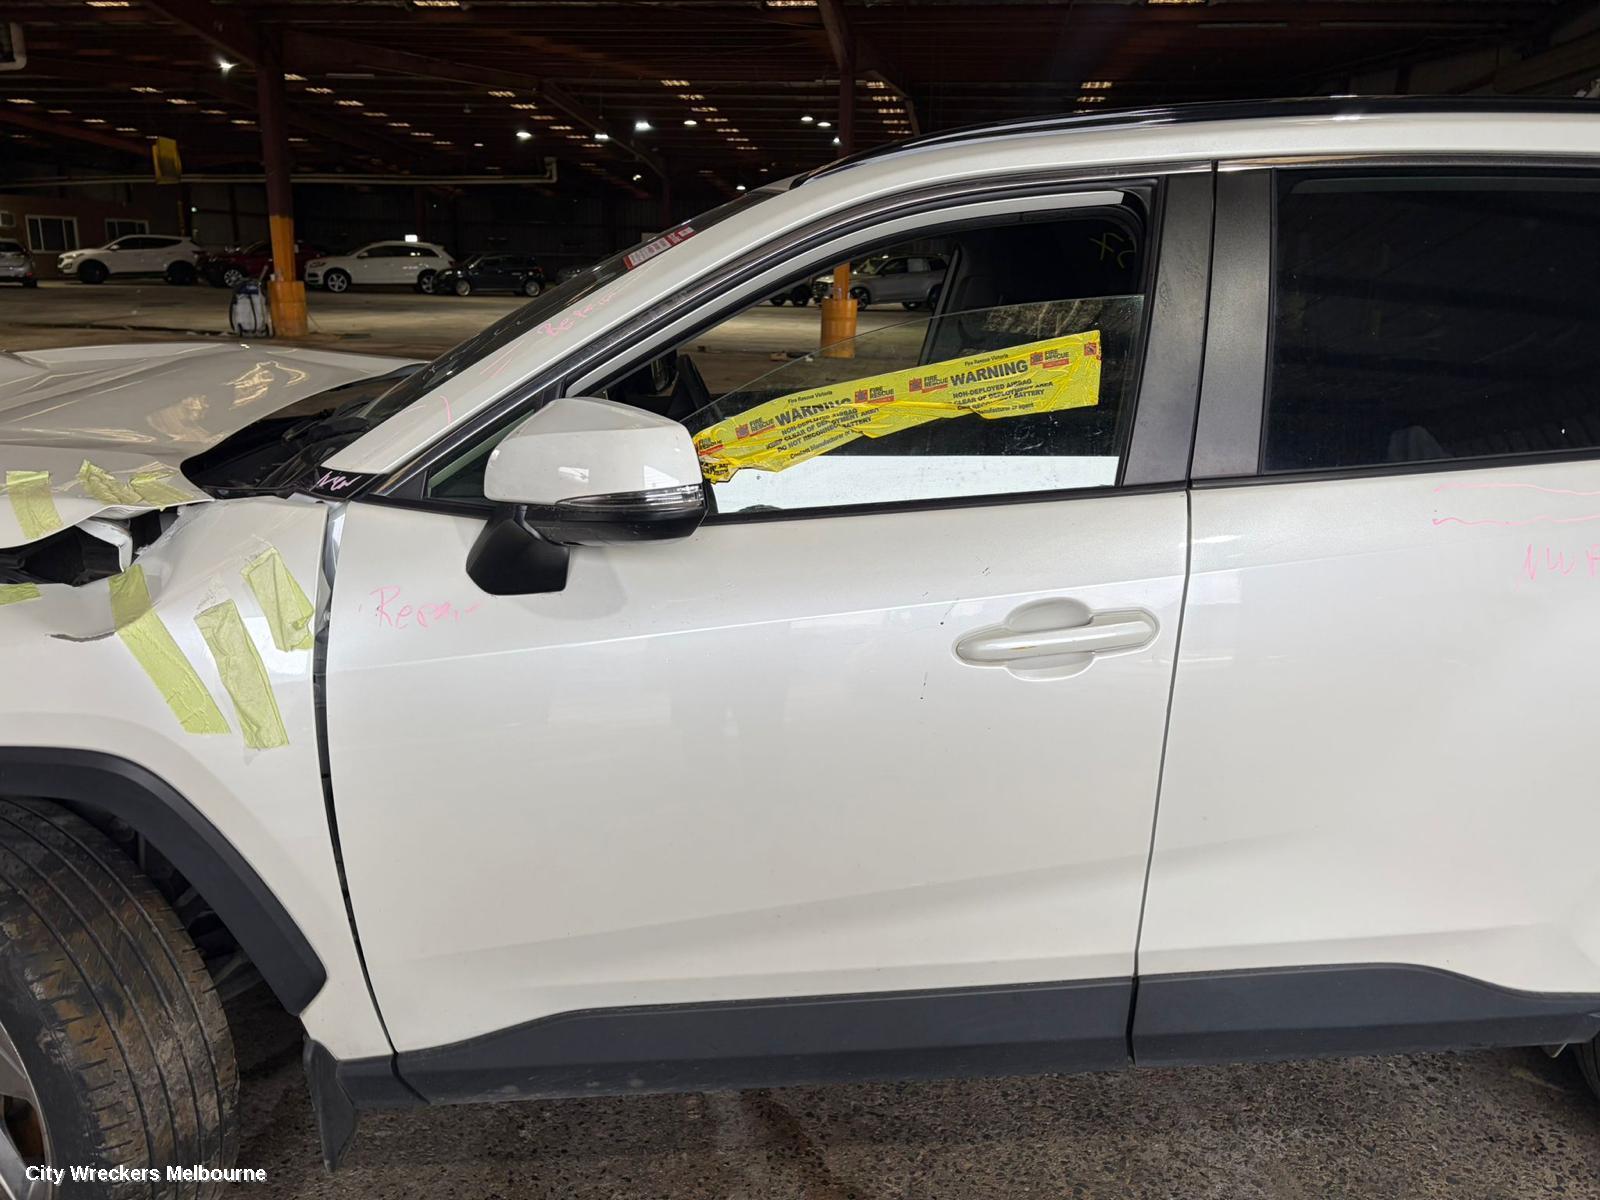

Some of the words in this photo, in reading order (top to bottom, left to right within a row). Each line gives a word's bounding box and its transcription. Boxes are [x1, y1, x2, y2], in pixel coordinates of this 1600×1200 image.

[950, 359, 1029, 386] WARNING
[924, 374, 938, 382] FIRE
[924, 377, 949, 388] RESCUE
[869, 385, 883, 393] FIRE
[953, 383, 1005, 399] NON-DEPLOYED
[806, 424, 816, 433] OF
[788, 439, 801, 448] NOT
